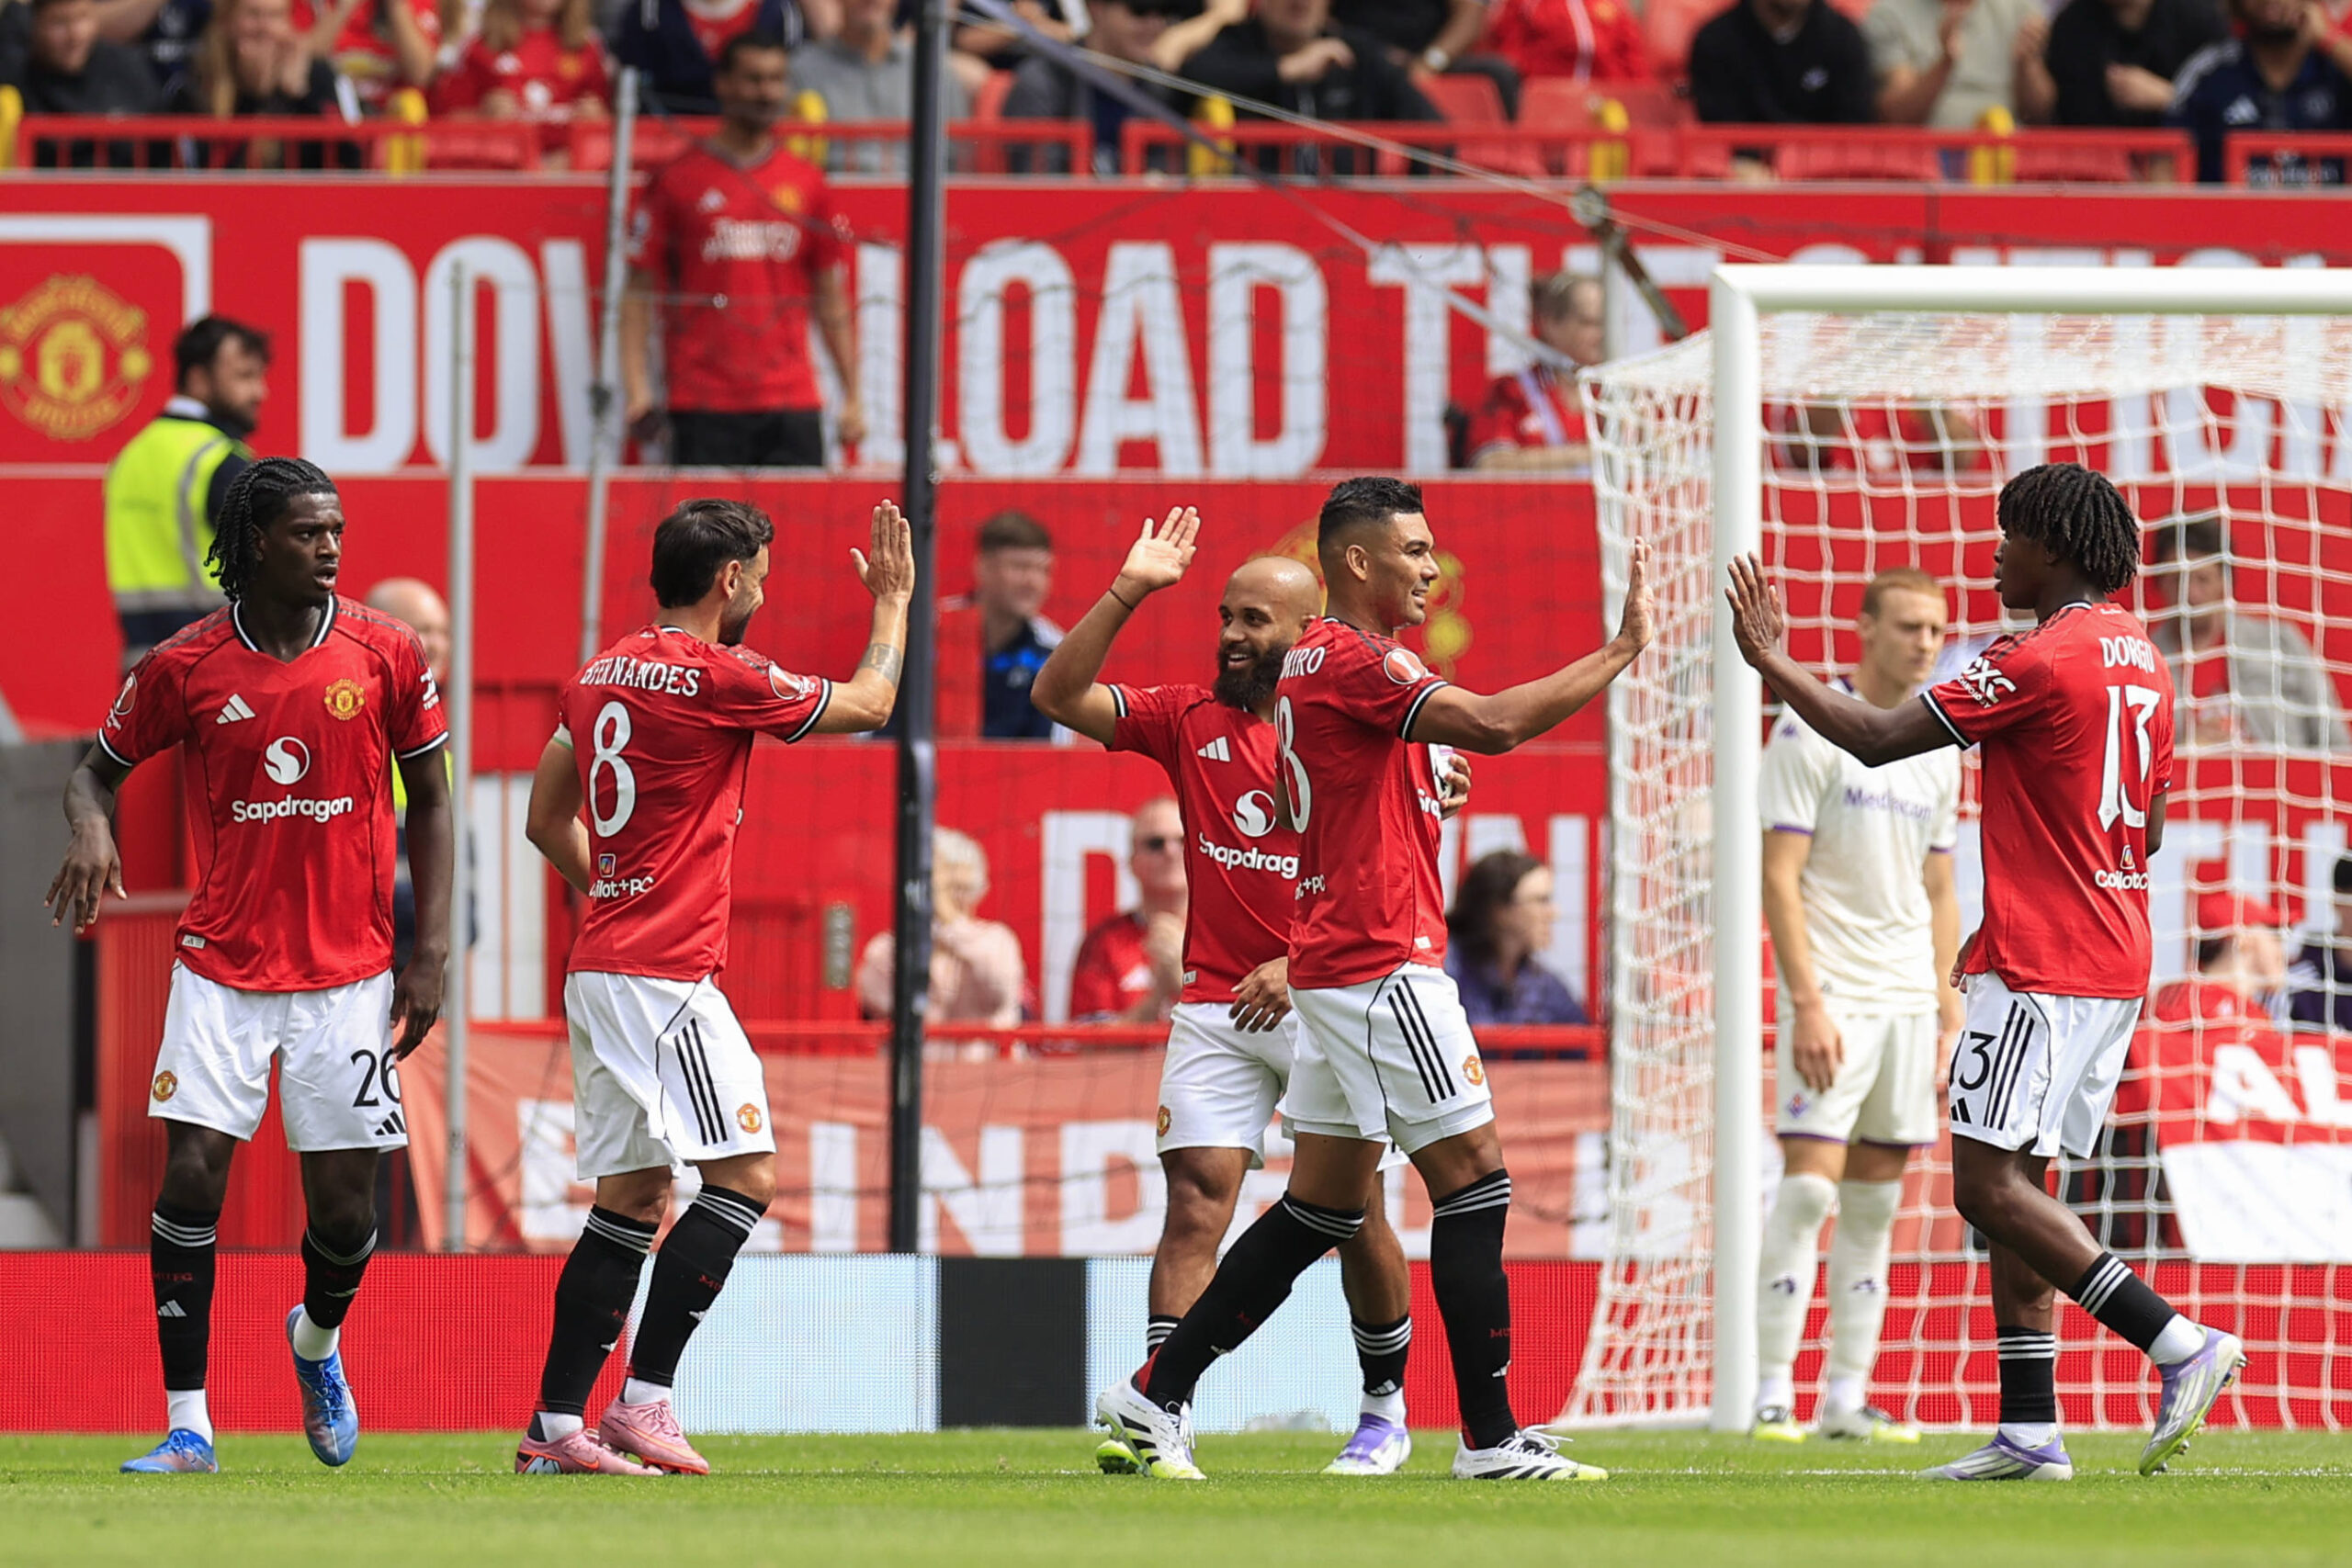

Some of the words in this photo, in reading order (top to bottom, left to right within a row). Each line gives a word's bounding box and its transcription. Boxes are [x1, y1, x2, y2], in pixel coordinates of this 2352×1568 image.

[2098, 635, 2156, 674] DORGU
[589, 700, 637, 838] 8
[2097, 684, 2161, 833] 13
[350, 1047, 401, 1108] 26
